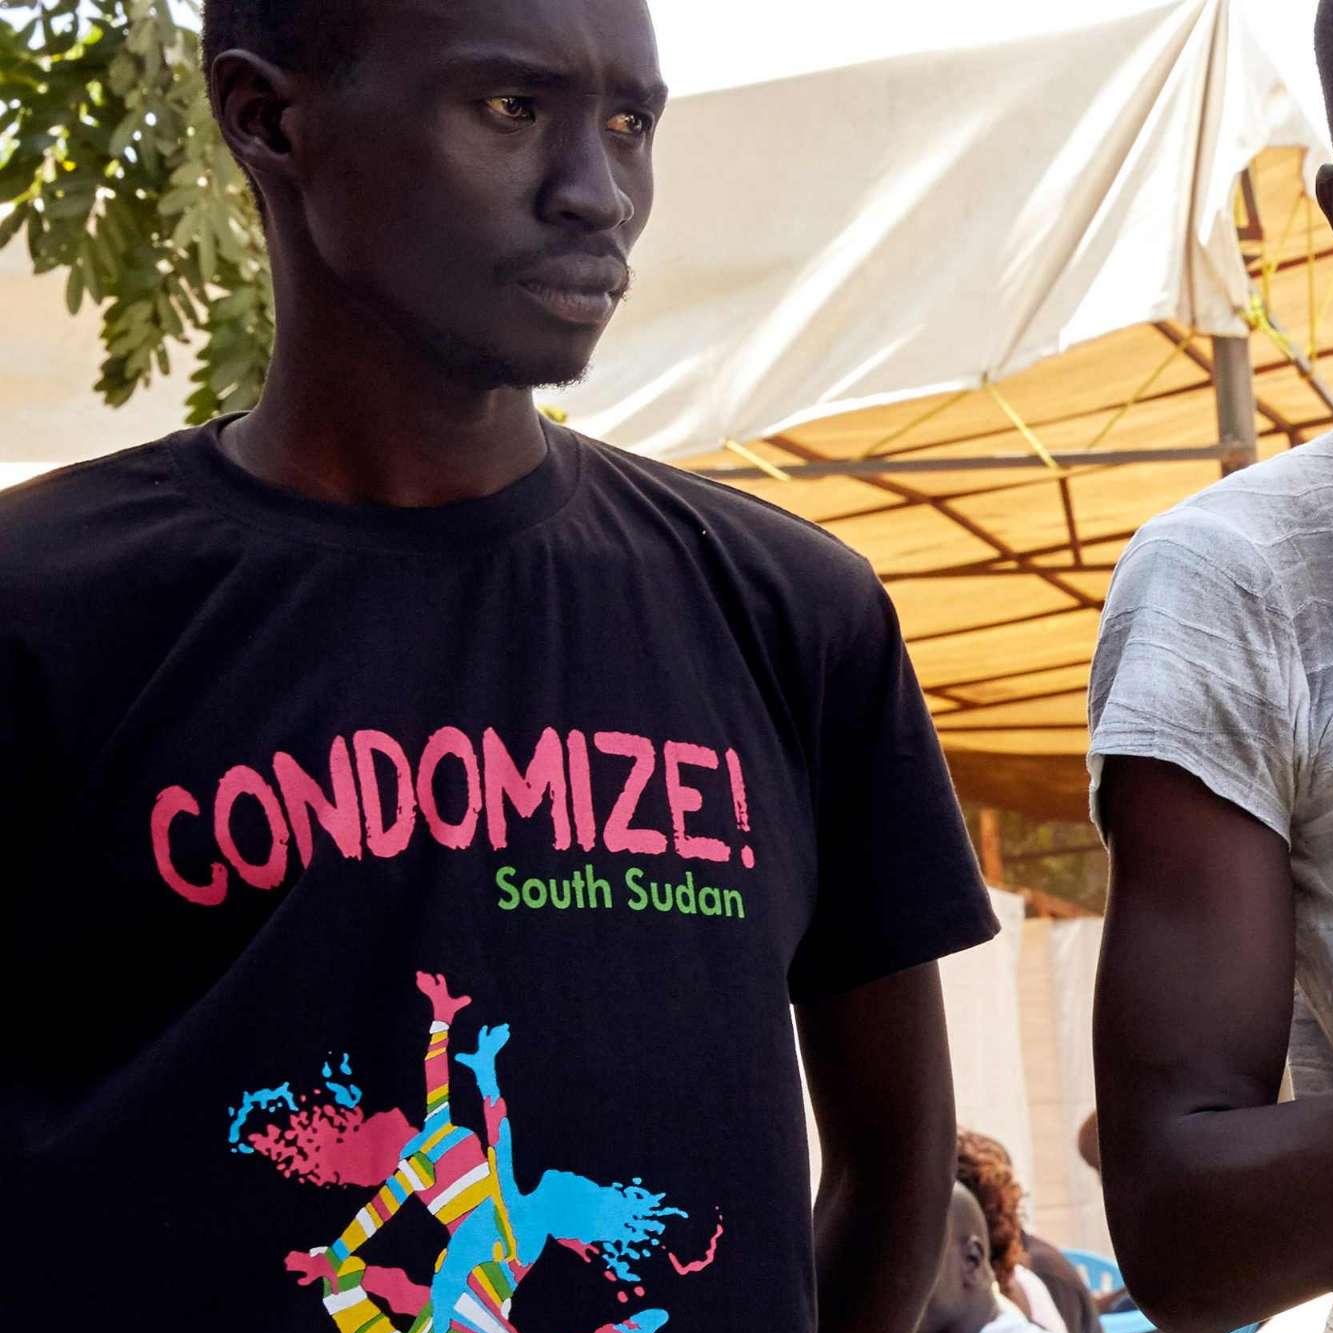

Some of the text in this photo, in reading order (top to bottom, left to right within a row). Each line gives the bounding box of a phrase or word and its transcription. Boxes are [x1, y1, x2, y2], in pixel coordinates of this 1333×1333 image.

[150, 725, 755, 906] CONDOMIZE!
[497, 864, 745, 919] South Sudan
